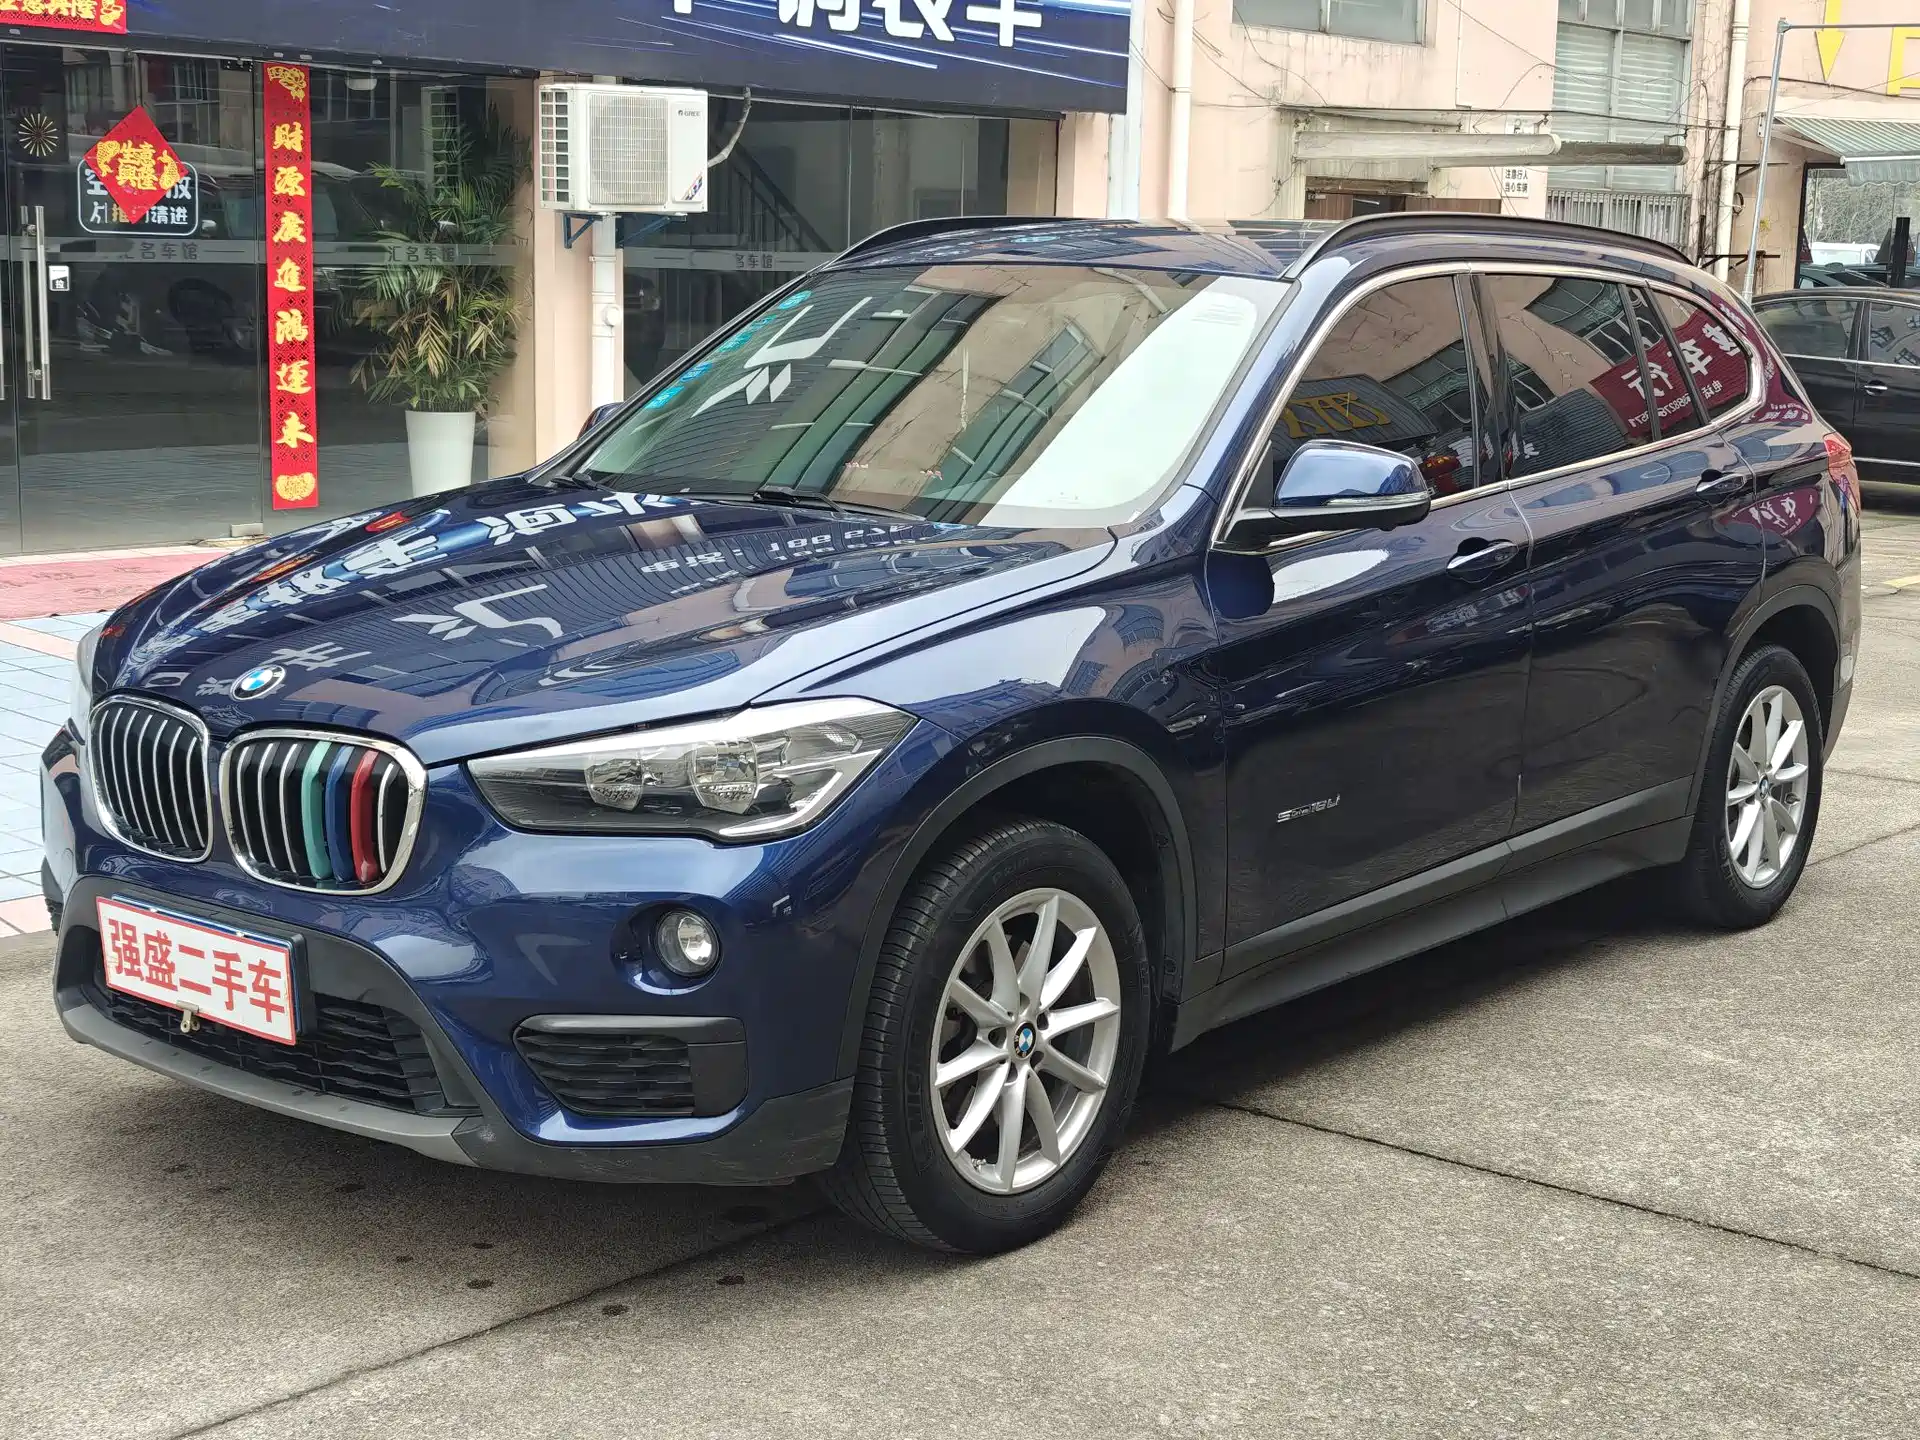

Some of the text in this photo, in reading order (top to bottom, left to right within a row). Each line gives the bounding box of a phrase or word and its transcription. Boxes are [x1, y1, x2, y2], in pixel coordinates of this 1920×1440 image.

[1505, 169, 1528, 179] 注意行人
[111, 203, 188, 225] 推请进
[108, 918, 286, 1023] 强盛二手车
